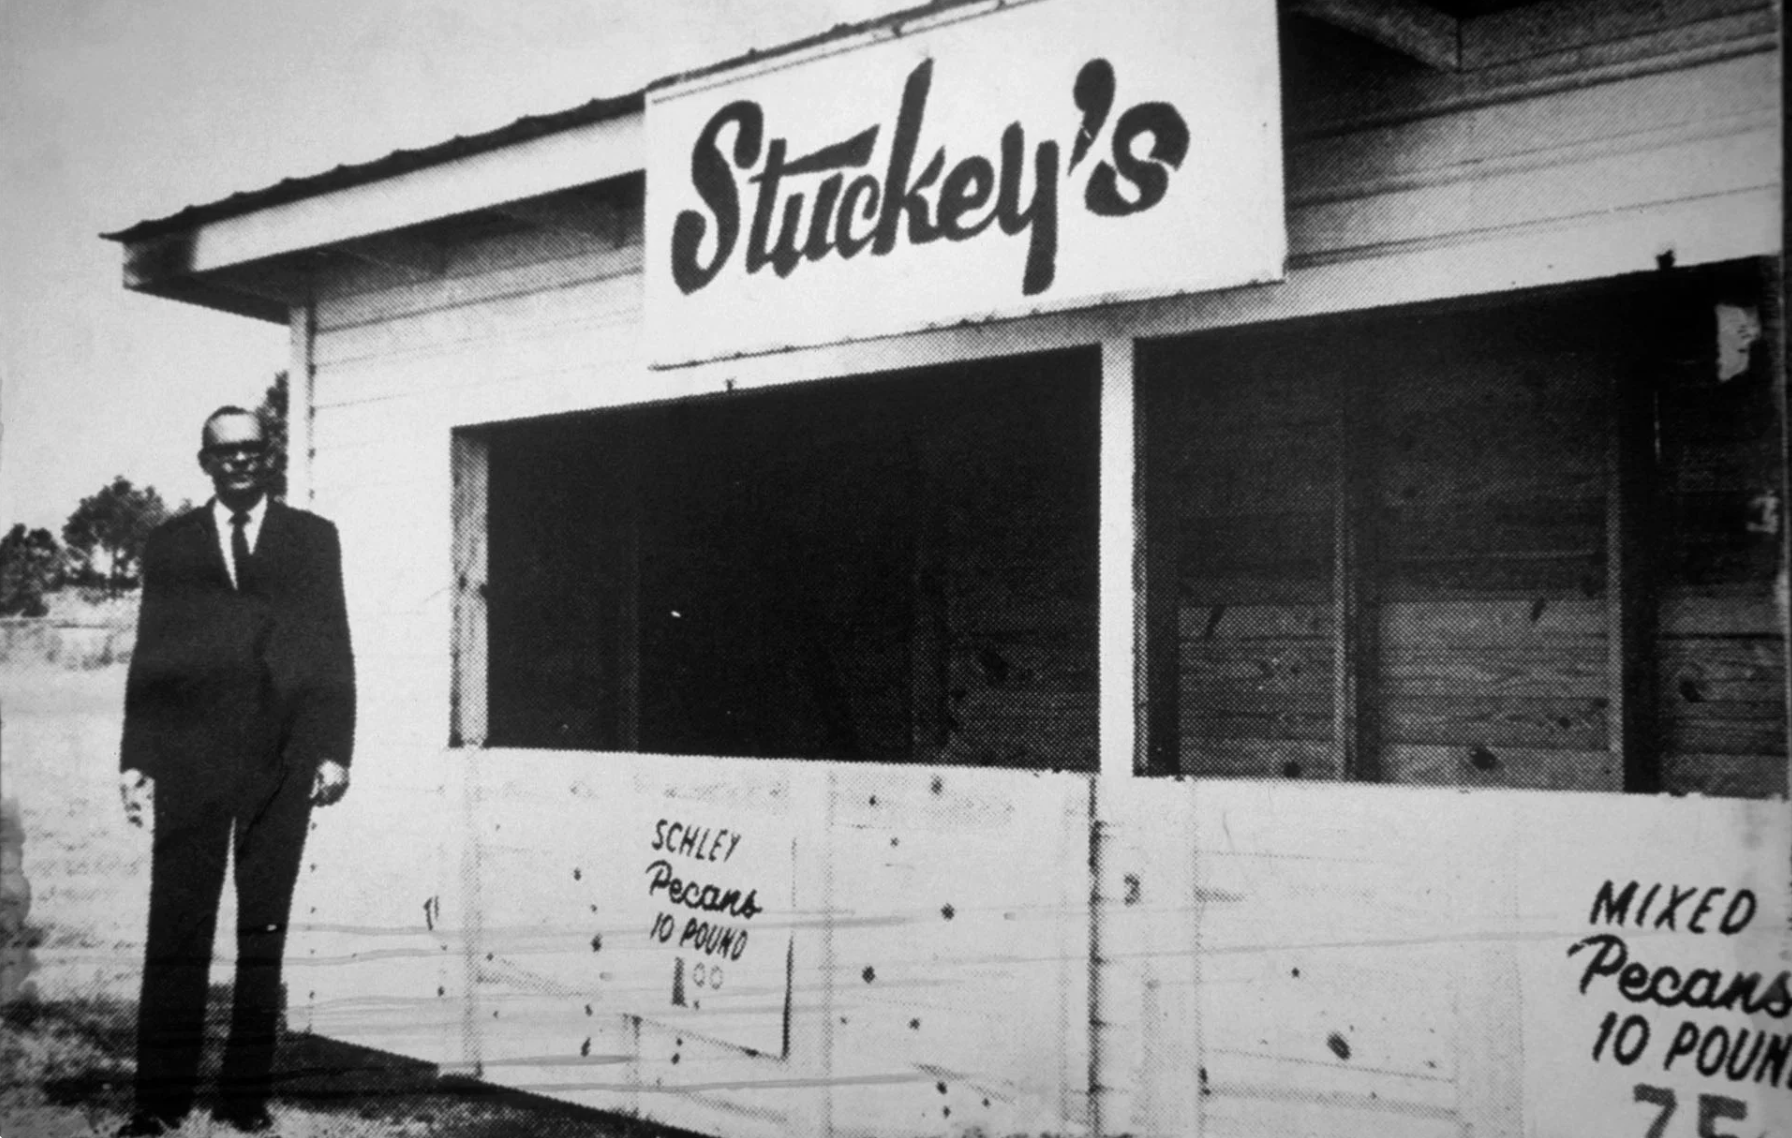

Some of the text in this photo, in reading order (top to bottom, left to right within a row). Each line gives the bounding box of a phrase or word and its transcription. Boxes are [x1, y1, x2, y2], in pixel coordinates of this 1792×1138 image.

[671, 57, 1190, 296] Stuckey's
[651, 818, 741, 862] SCHLEY
[645, 859, 763, 919] Pecans
[1589, 880, 1758, 935] MIXED
[650, 912, 748, 961] 10 POUND
[1567, 934, 1792, 1018] Pecans
[1592, 1011, 1792, 1089] 10 POUN
